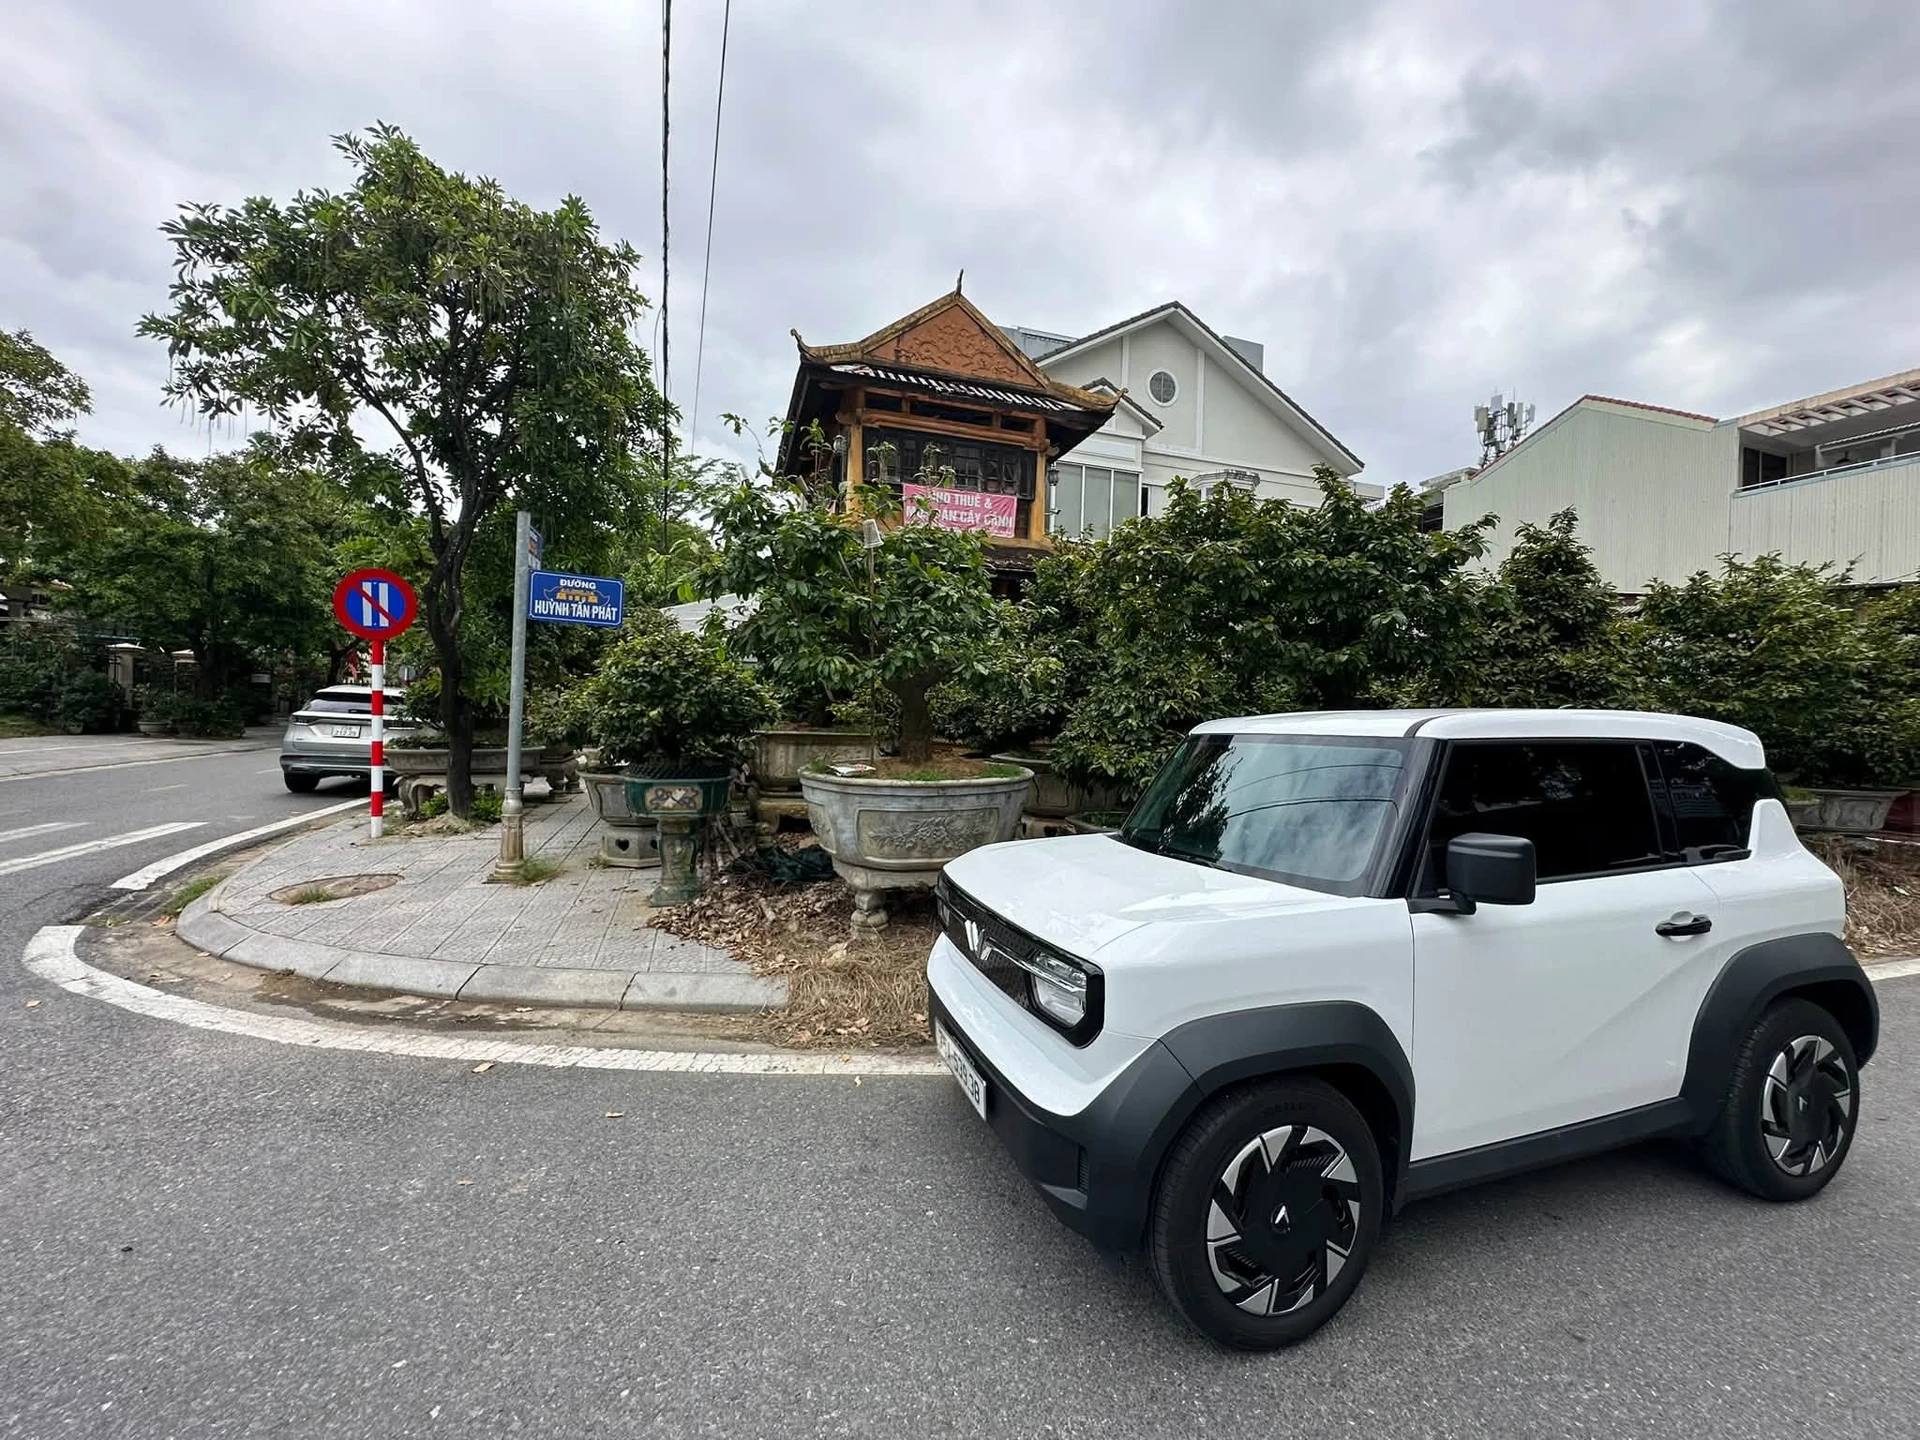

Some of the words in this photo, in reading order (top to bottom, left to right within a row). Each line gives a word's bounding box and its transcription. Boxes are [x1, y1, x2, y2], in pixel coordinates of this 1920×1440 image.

[954, 491, 981, 508] THUÊ
[984, 497, 992, 510] &
[559, 578, 597, 590] ĐƯỜNG
[534, 598, 569, 617] HUỲNH
[591, 604, 618, 621] PHÁT
